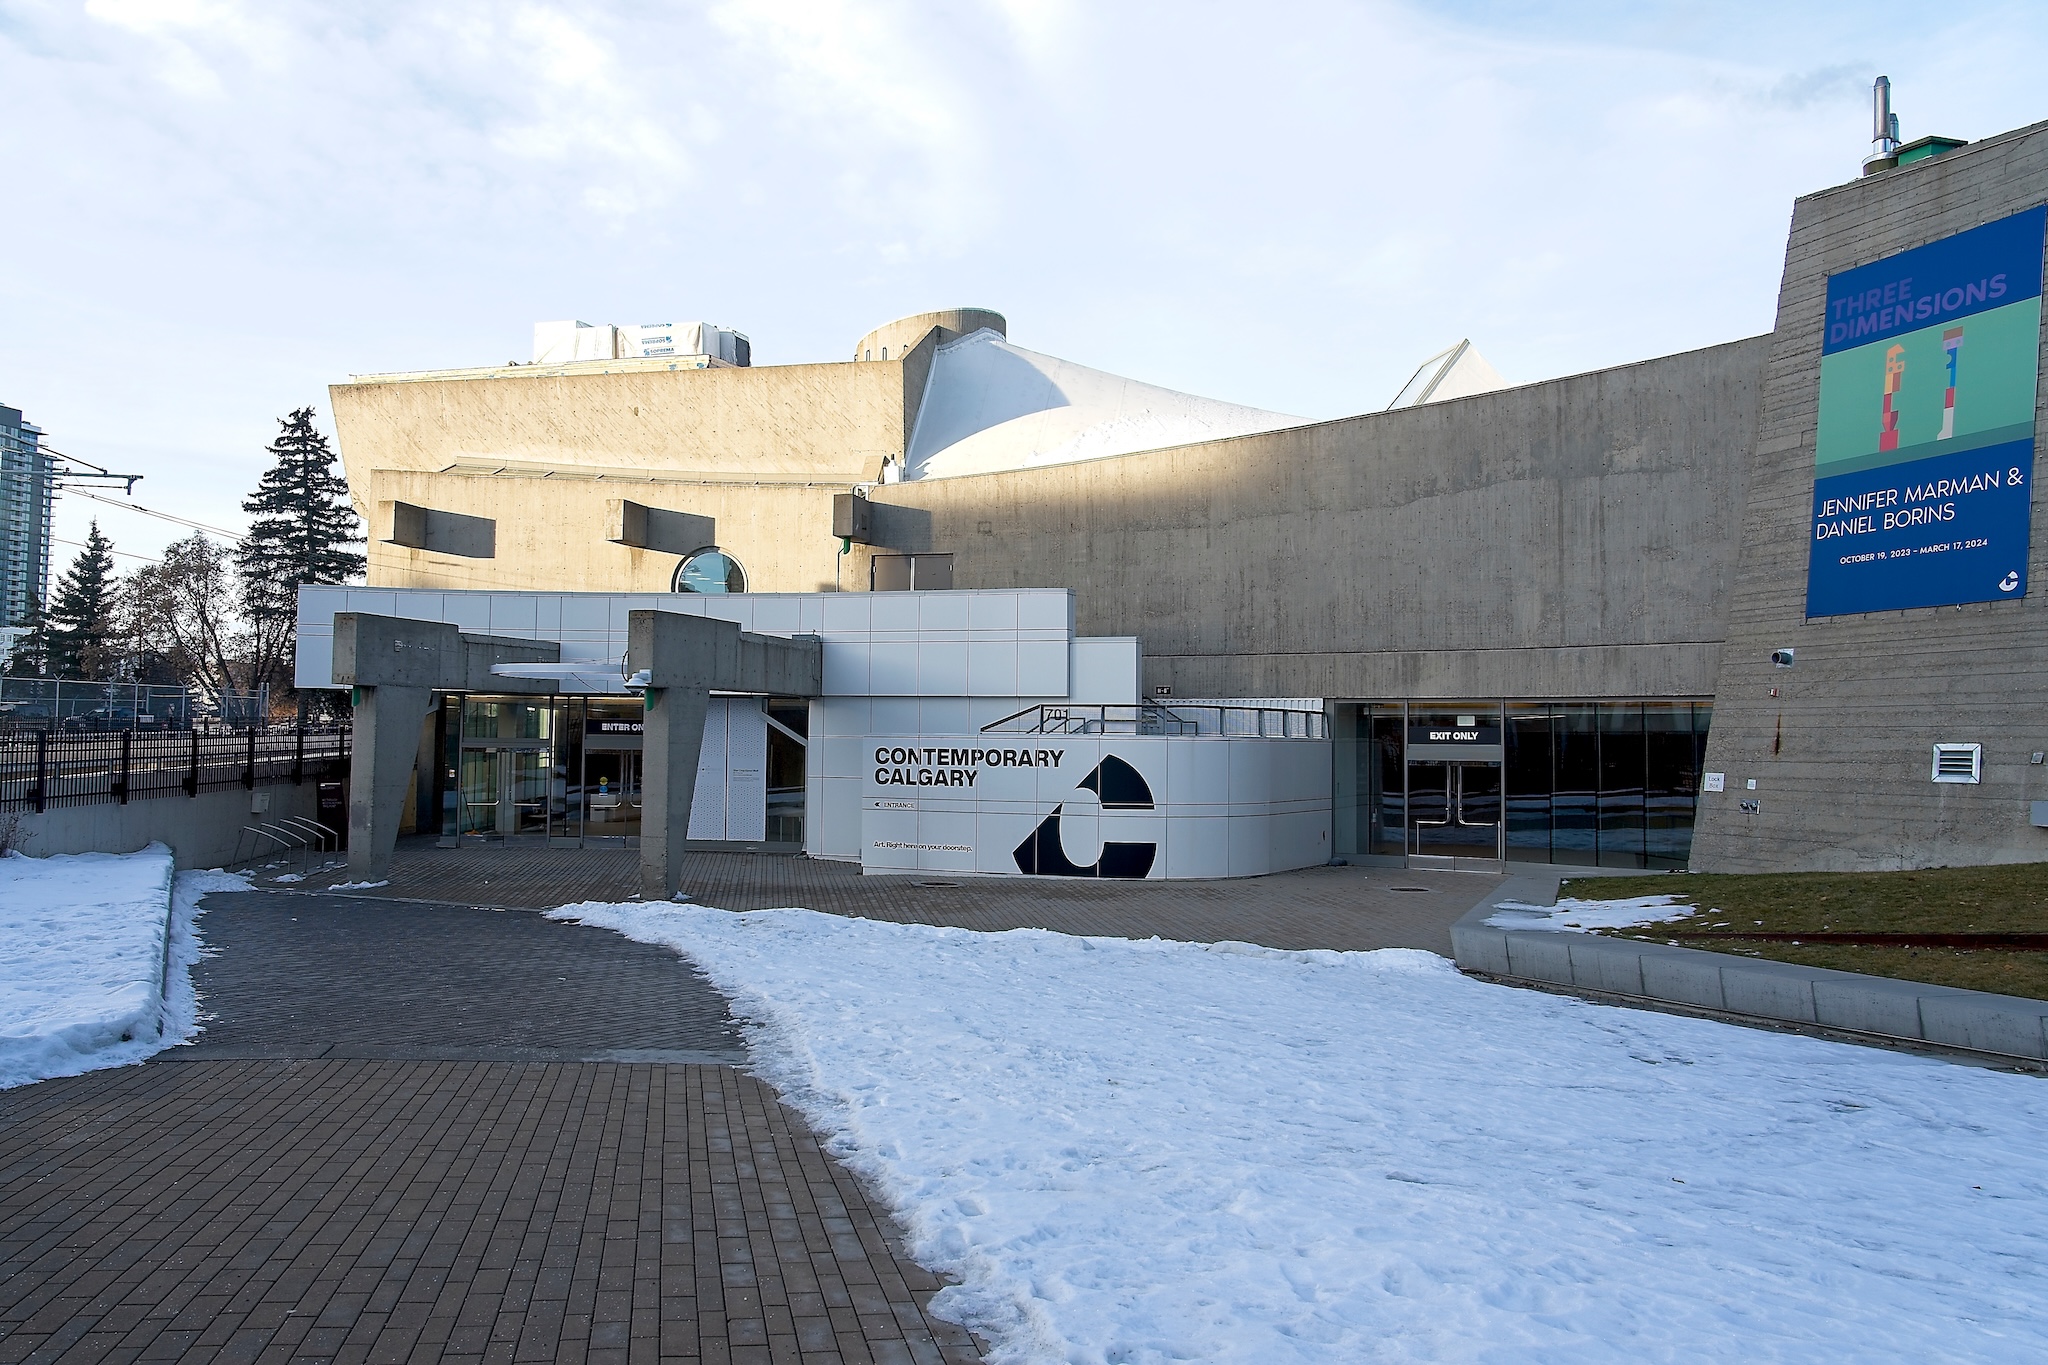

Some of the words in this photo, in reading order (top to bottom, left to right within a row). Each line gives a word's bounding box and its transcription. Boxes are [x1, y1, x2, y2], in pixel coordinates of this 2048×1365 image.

[1830, 274, 2007, 344] DIMENSIONS
[1832, 277, 1912, 320] THREE
[1818, 489, 1898, 518] JENNIFER
[1904, 470, 2000, 503] MARMAN
[2007, 467, 2024, 486] &
[1816, 515, 1876, 540] DANIEL
[1883, 502, 1955, 530] BORINS
[1839, 553, 1875, 565] OCTOBER
[1877, 551, 1888, 561] 19,
[1890, 548, 1911, 558] 2023
[1919, 543, 1950, 554] MARCH
[1952, 541, 1964, 550] 17,
[1965, 538, 1988, 548] 2024
[602, 723, 631, 731] ENTER
[1430, 732, 1451, 740] EXIT
[1453, 732, 1479, 740] ONLY
[874, 747, 1065, 768] CONTEMPORARY
[874, 768, 979, 787] CALGARY
[886, 842, 903, 850] Right
[942, 844, 973, 853] doorstep.
